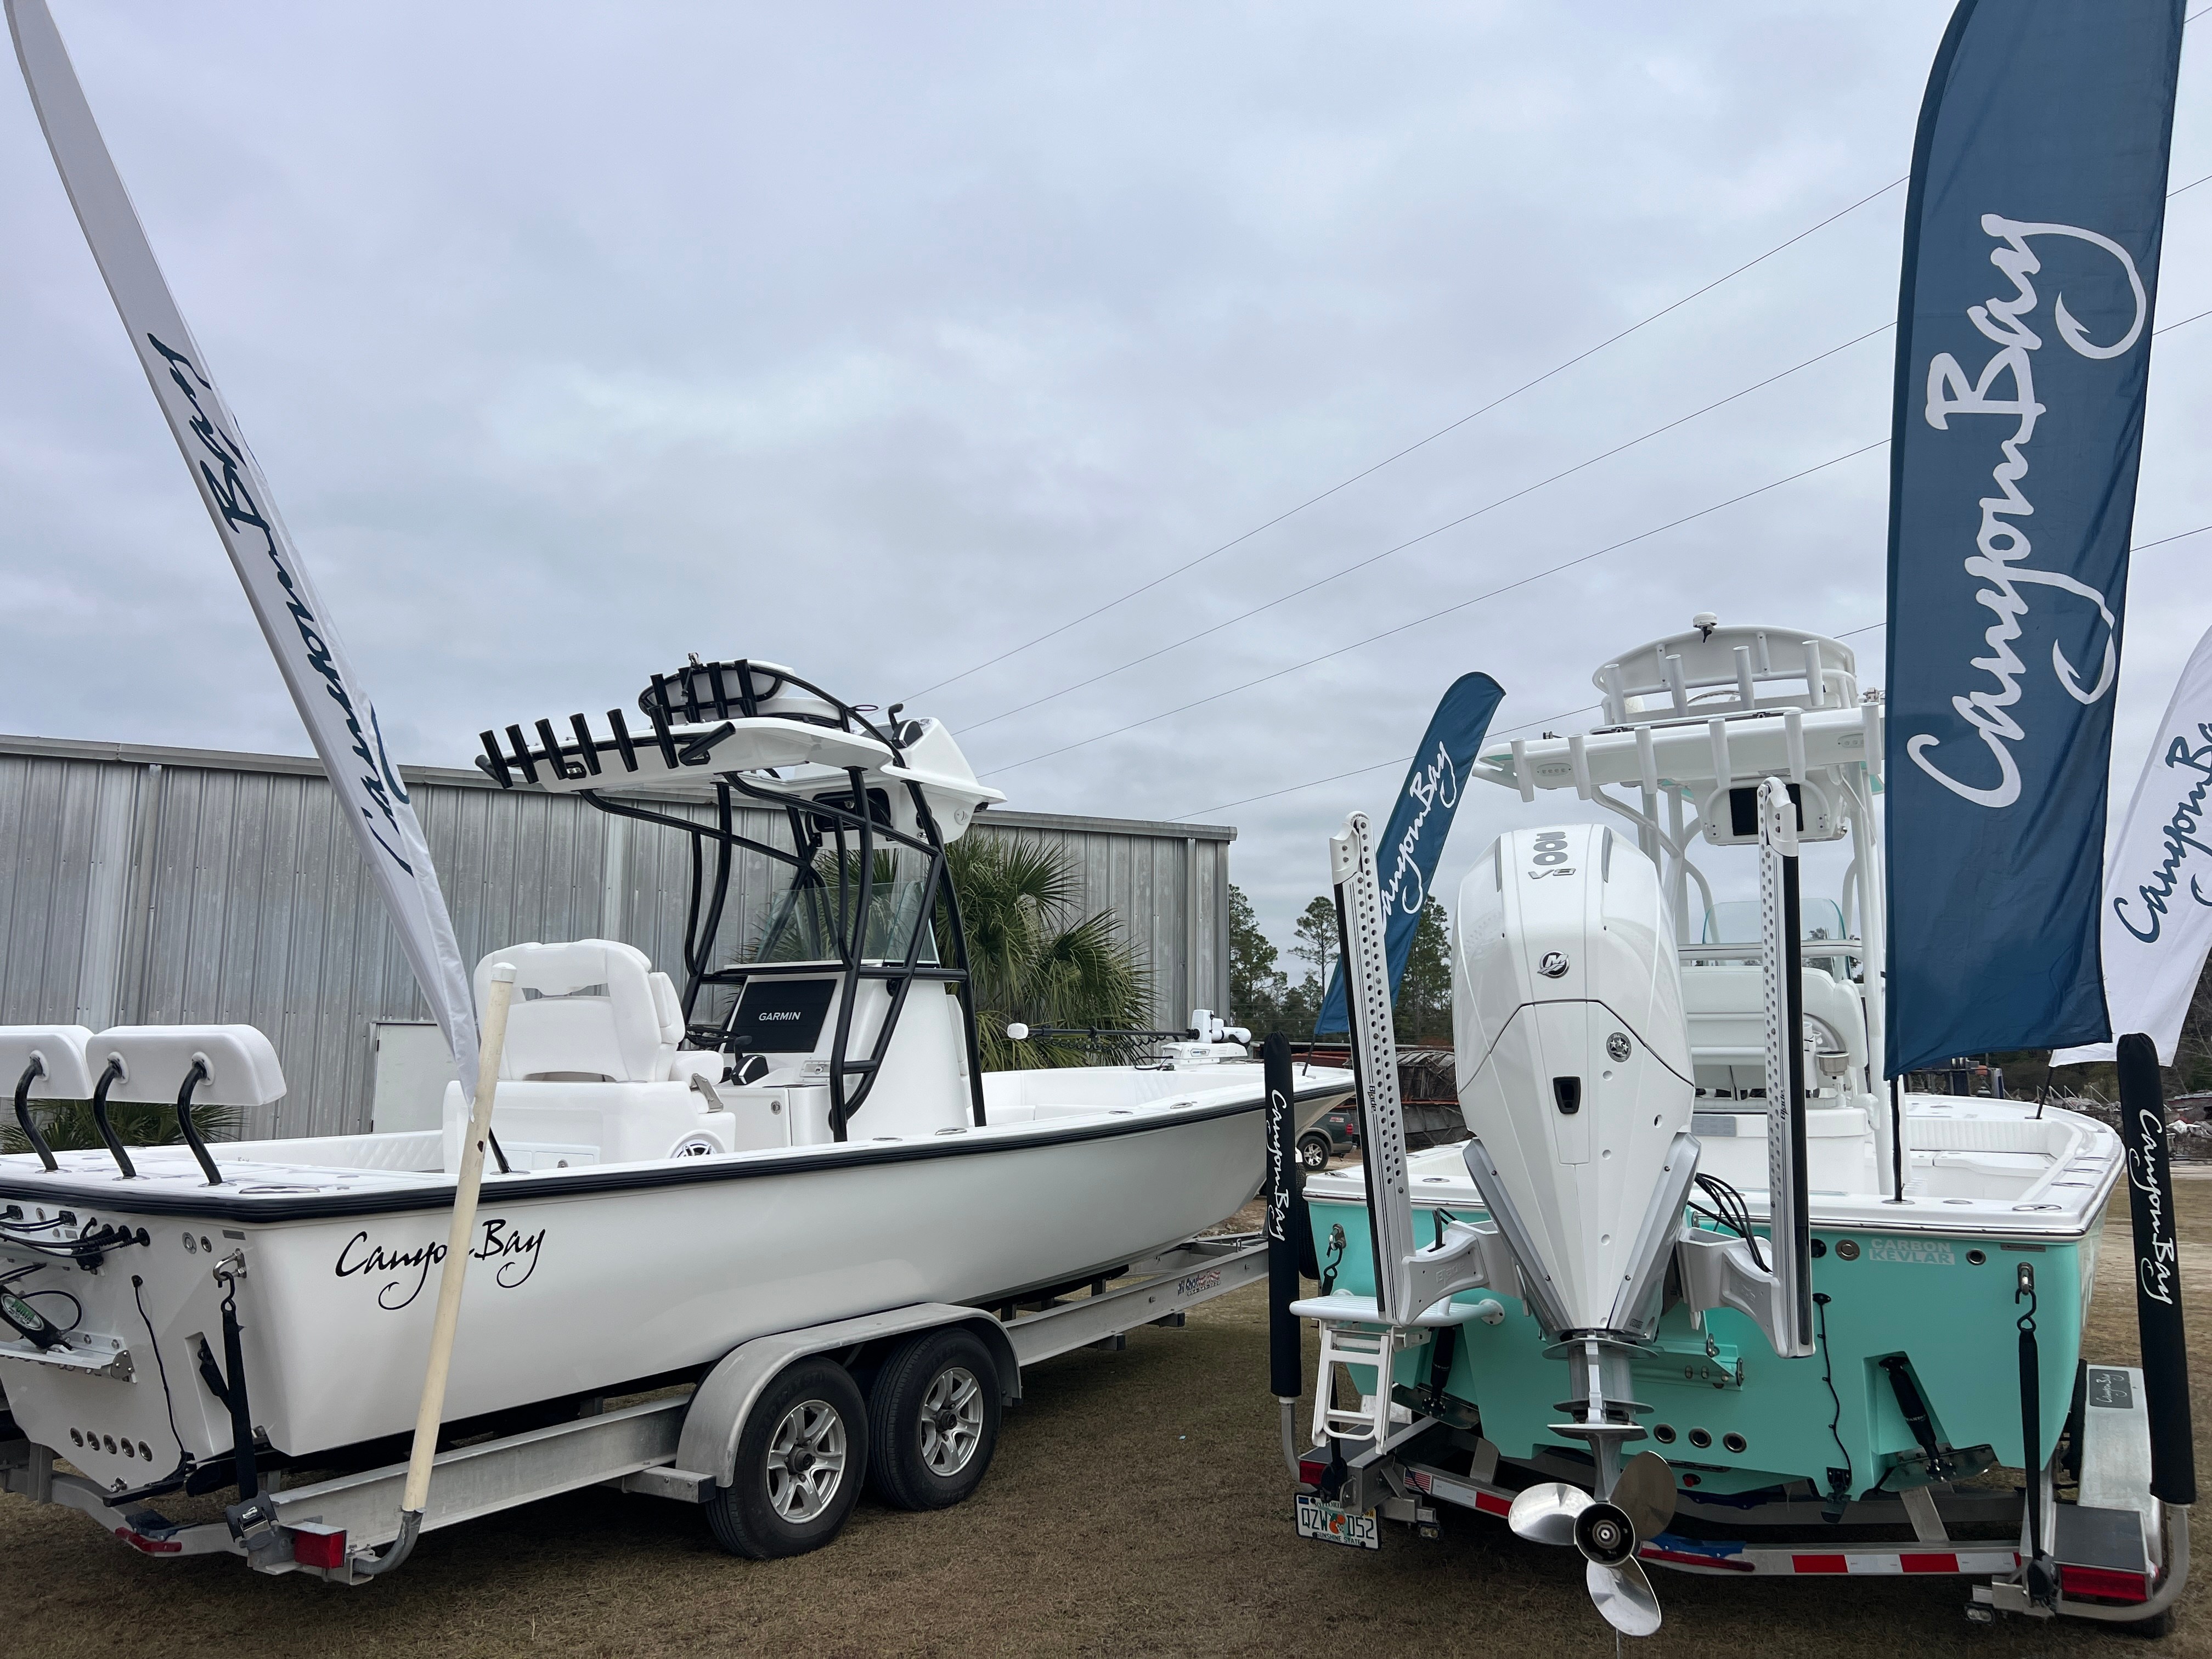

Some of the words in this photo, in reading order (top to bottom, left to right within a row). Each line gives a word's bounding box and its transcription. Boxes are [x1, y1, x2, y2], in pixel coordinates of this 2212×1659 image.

[758, 1012, 802, 1022] GARMIN
[1367, 1085, 1377, 1112] Blade
[1780, 1090, 1789, 1120] Blade
[1871, 1238, 1951, 1252] CARBON
[1871, 1250, 1951, 1265] KEVLAR
[1301, 1508, 1328, 1532] QZW
[1346, 1515, 1375, 1540] D52
[1316, 1531, 1342, 1542] SUNSHINE
